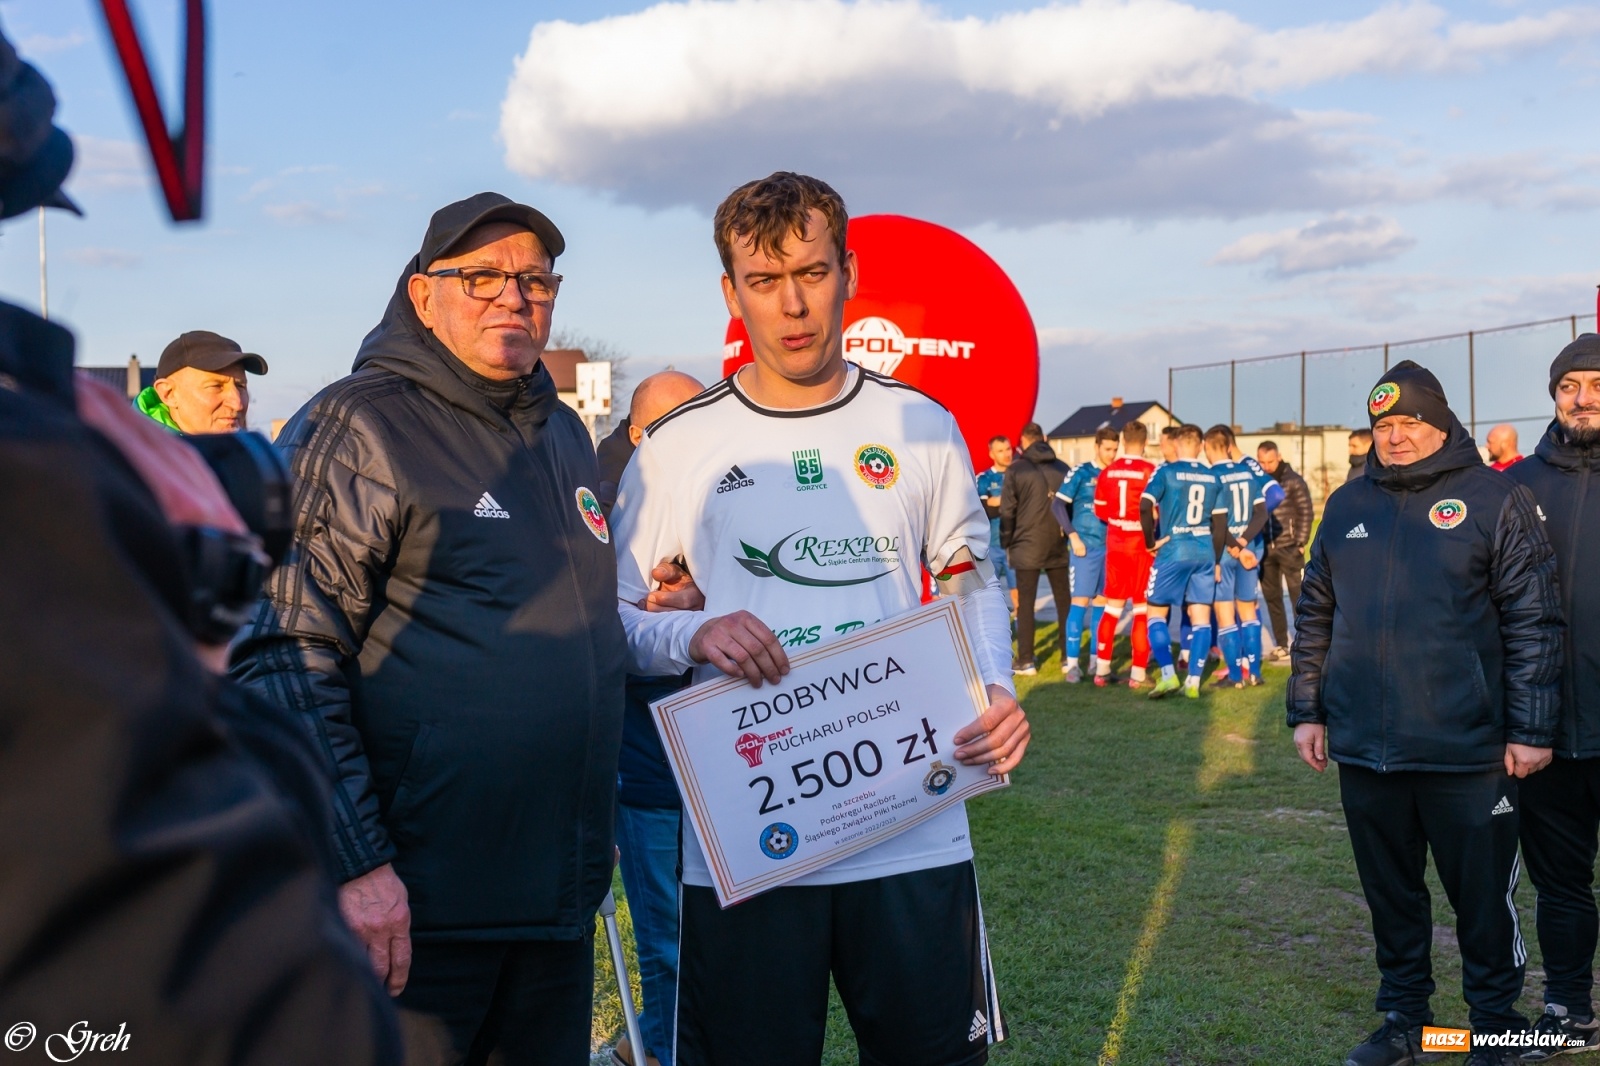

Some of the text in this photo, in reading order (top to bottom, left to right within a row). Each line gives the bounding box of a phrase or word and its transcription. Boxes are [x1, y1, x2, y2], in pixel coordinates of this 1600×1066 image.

[846, 337, 975, 359] POLTENT
[797, 458, 819, 475] BS
[716, 478, 755, 494] adidas
[796, 483, 828, 492] GORZYCE
[1118, 479, 1128, 518] 1
[474, 508, 511, 519] adidas
[1186, 483, 1205, 526] 8
[1229, 481, 1250, 523] 11
[794, 535, 899, 567] REKPOL
[828, 558, 848, 566] Śląskie
[848, 556, 871, 564] Centrum
[773, 625, 822, 647] CHS
[731, 656, 906, 731] ZDOBYWCA
[736, 726, 793, 753] POLTENT
[768, 699, 901, 756] PUCHARU POLSKI
[748, 739, 883, 815] 2.500
[896, 717, 938, 765] zł
[820, 793, 897, 826] Podokręgu Racibórz
[832, 790, 876, 811] na szczeblu
[1491, 805, 1514, 815] adidas
[804, 826, 841, 844] Śląskiego
[842, 814, 873, 831] Związku
[873, 806, 890, 818] Piłki
[891, 795, 918, 811] Nożnej
[840, 830, 864, 844] sezonie
[865, 816, 897, 834] 2022/2023
[968, 1024, 988, 1042] adida
